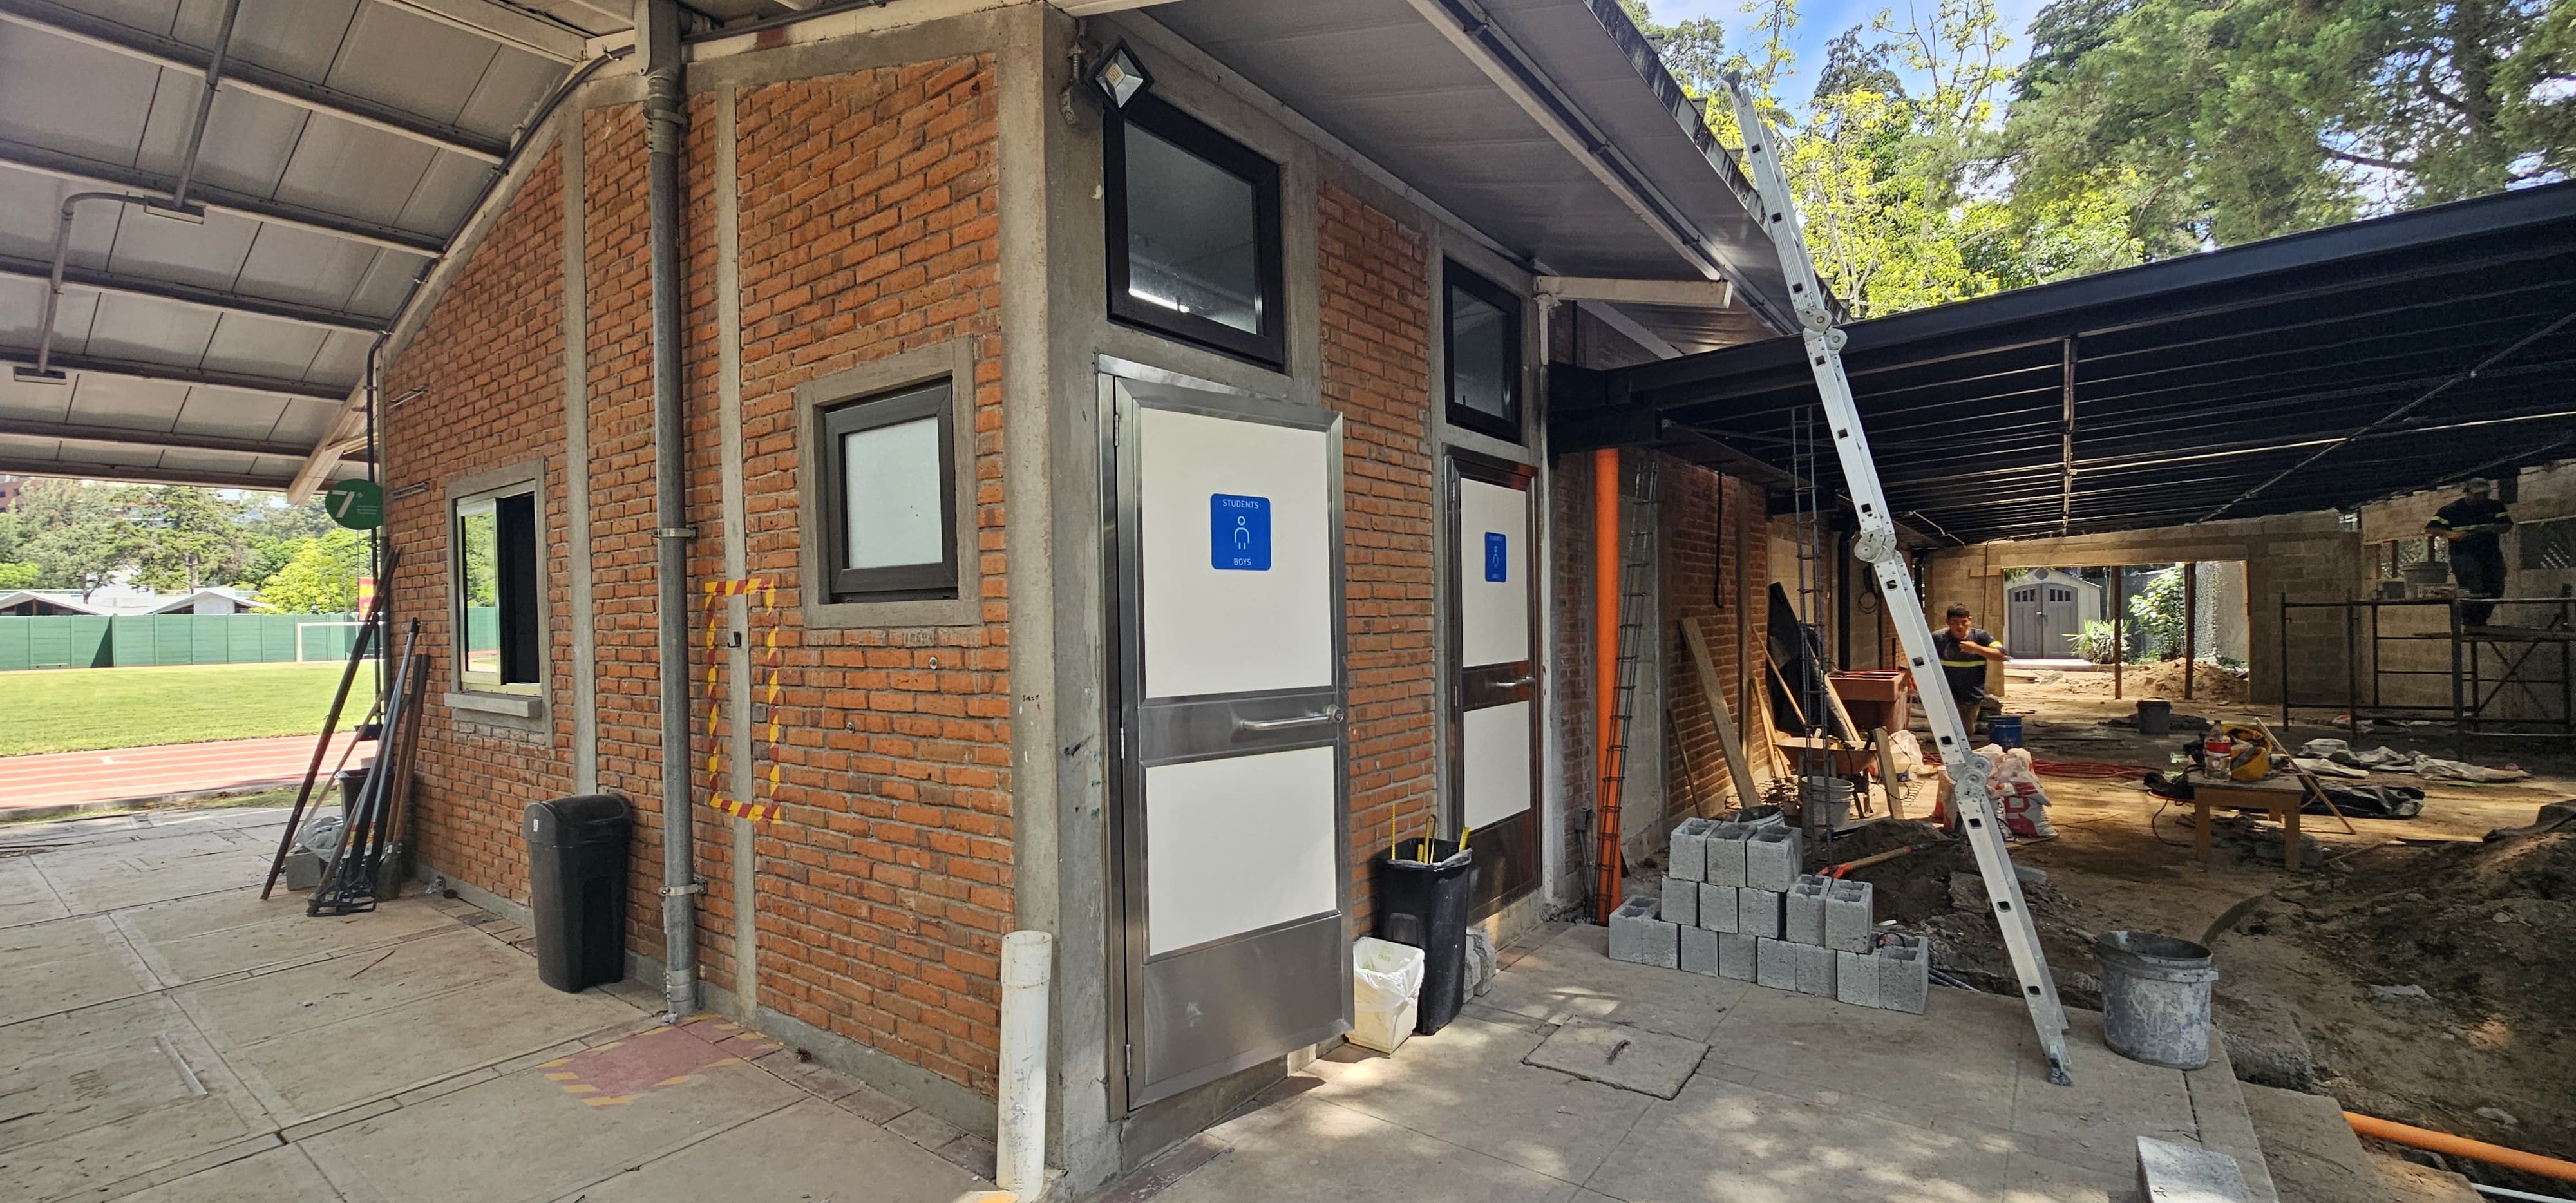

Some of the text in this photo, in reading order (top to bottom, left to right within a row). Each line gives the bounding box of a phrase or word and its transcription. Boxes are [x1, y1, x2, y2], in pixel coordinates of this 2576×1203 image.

[332, 490, 355, 518] 7
[1222, 498, 1259, 509] STUDENTS
[1233, 558, 1251, 566] BOYS
